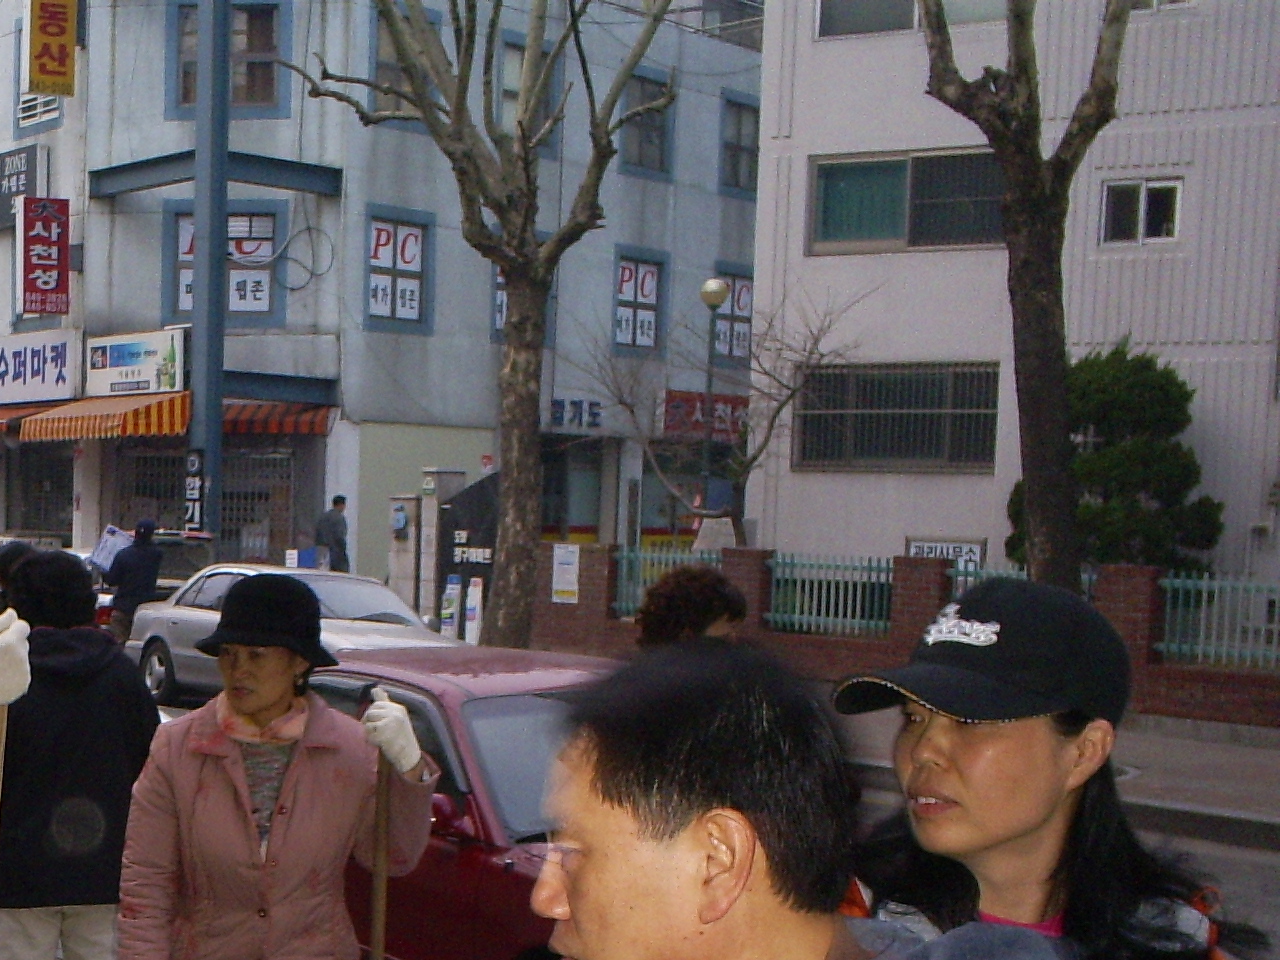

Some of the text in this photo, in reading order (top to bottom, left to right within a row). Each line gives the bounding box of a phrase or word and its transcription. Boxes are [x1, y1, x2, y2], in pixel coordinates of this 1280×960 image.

[5, 153, 28, 176] ZONE
[370, 227, 420, 265] PC
[618, 264, 655, 299] PC
